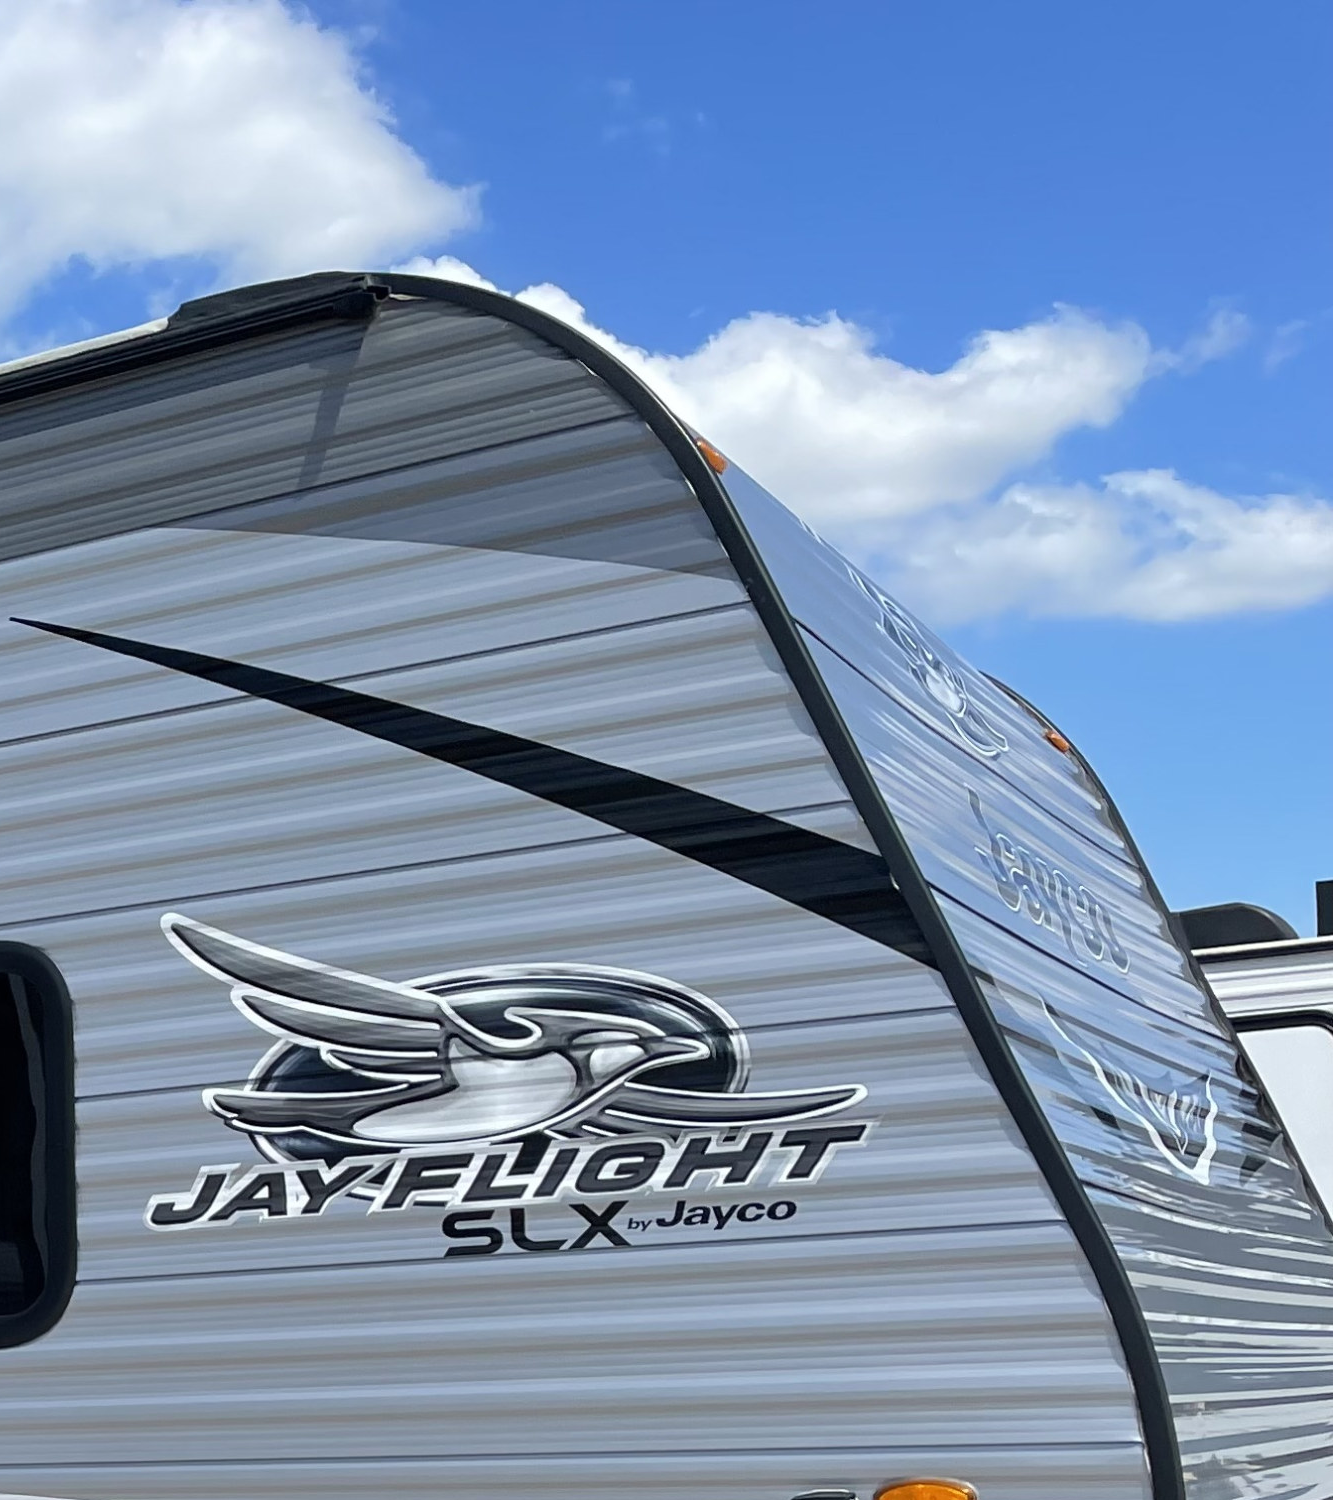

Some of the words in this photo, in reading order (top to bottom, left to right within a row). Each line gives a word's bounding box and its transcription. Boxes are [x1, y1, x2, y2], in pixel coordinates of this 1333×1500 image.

[146, 1158, 379, 1231] JAY
[375, 1116, 879, 1212] FLIGHT
[443, 1199, 632, 1257] SLX
[627, 1217, 653, 1232] by
[655, 1199, 797, 1231] Jayco
